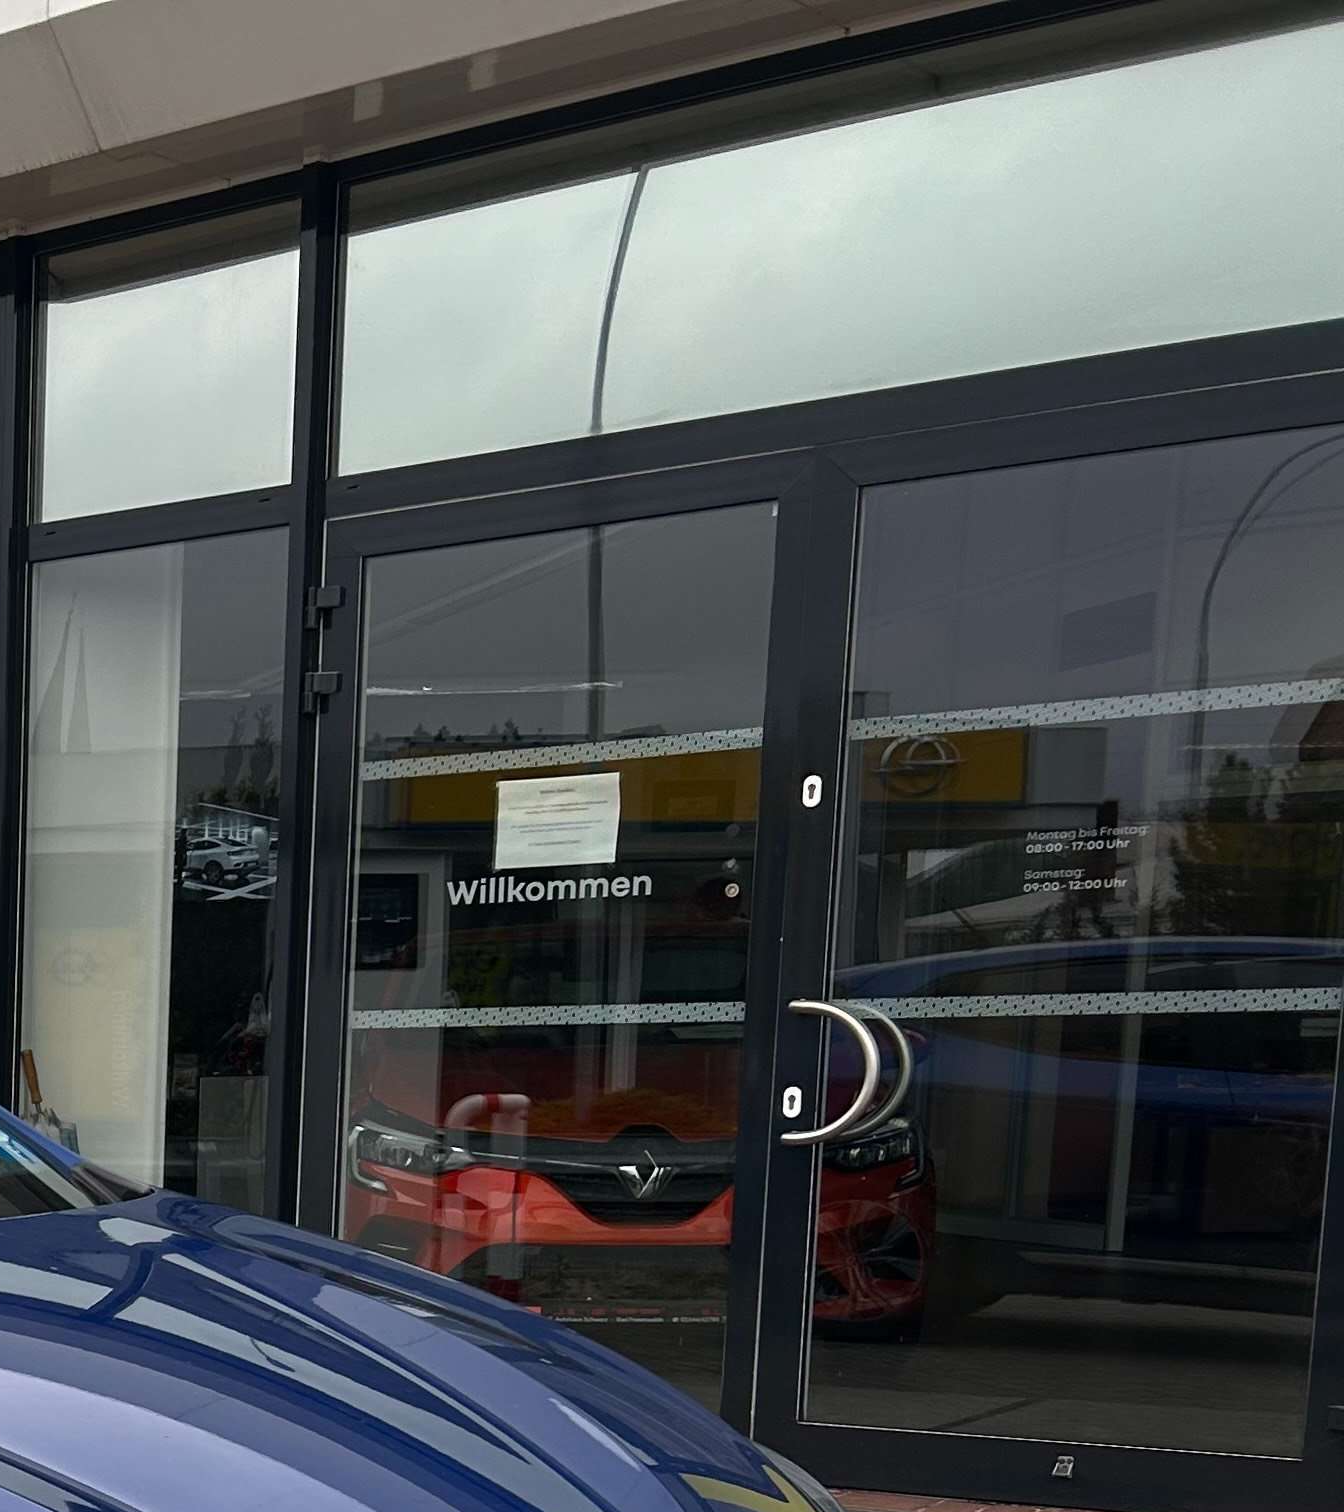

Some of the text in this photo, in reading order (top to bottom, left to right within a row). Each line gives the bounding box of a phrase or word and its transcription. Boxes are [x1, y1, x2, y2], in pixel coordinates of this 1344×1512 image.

[1026, 829, 1077, 842] Montag
[1078, 827, 1097, 838] bis
[1026, 842, 1063, 854] 08:00
[1072, 840, 1104, 851] 17:00
[1106, 838, 1130, 849] Uhr
[447, 875, 652, 905] Willkommen
[1069, 879, 1102, 890] 12:00
[1104, 878, 1128, 889] Uhr
